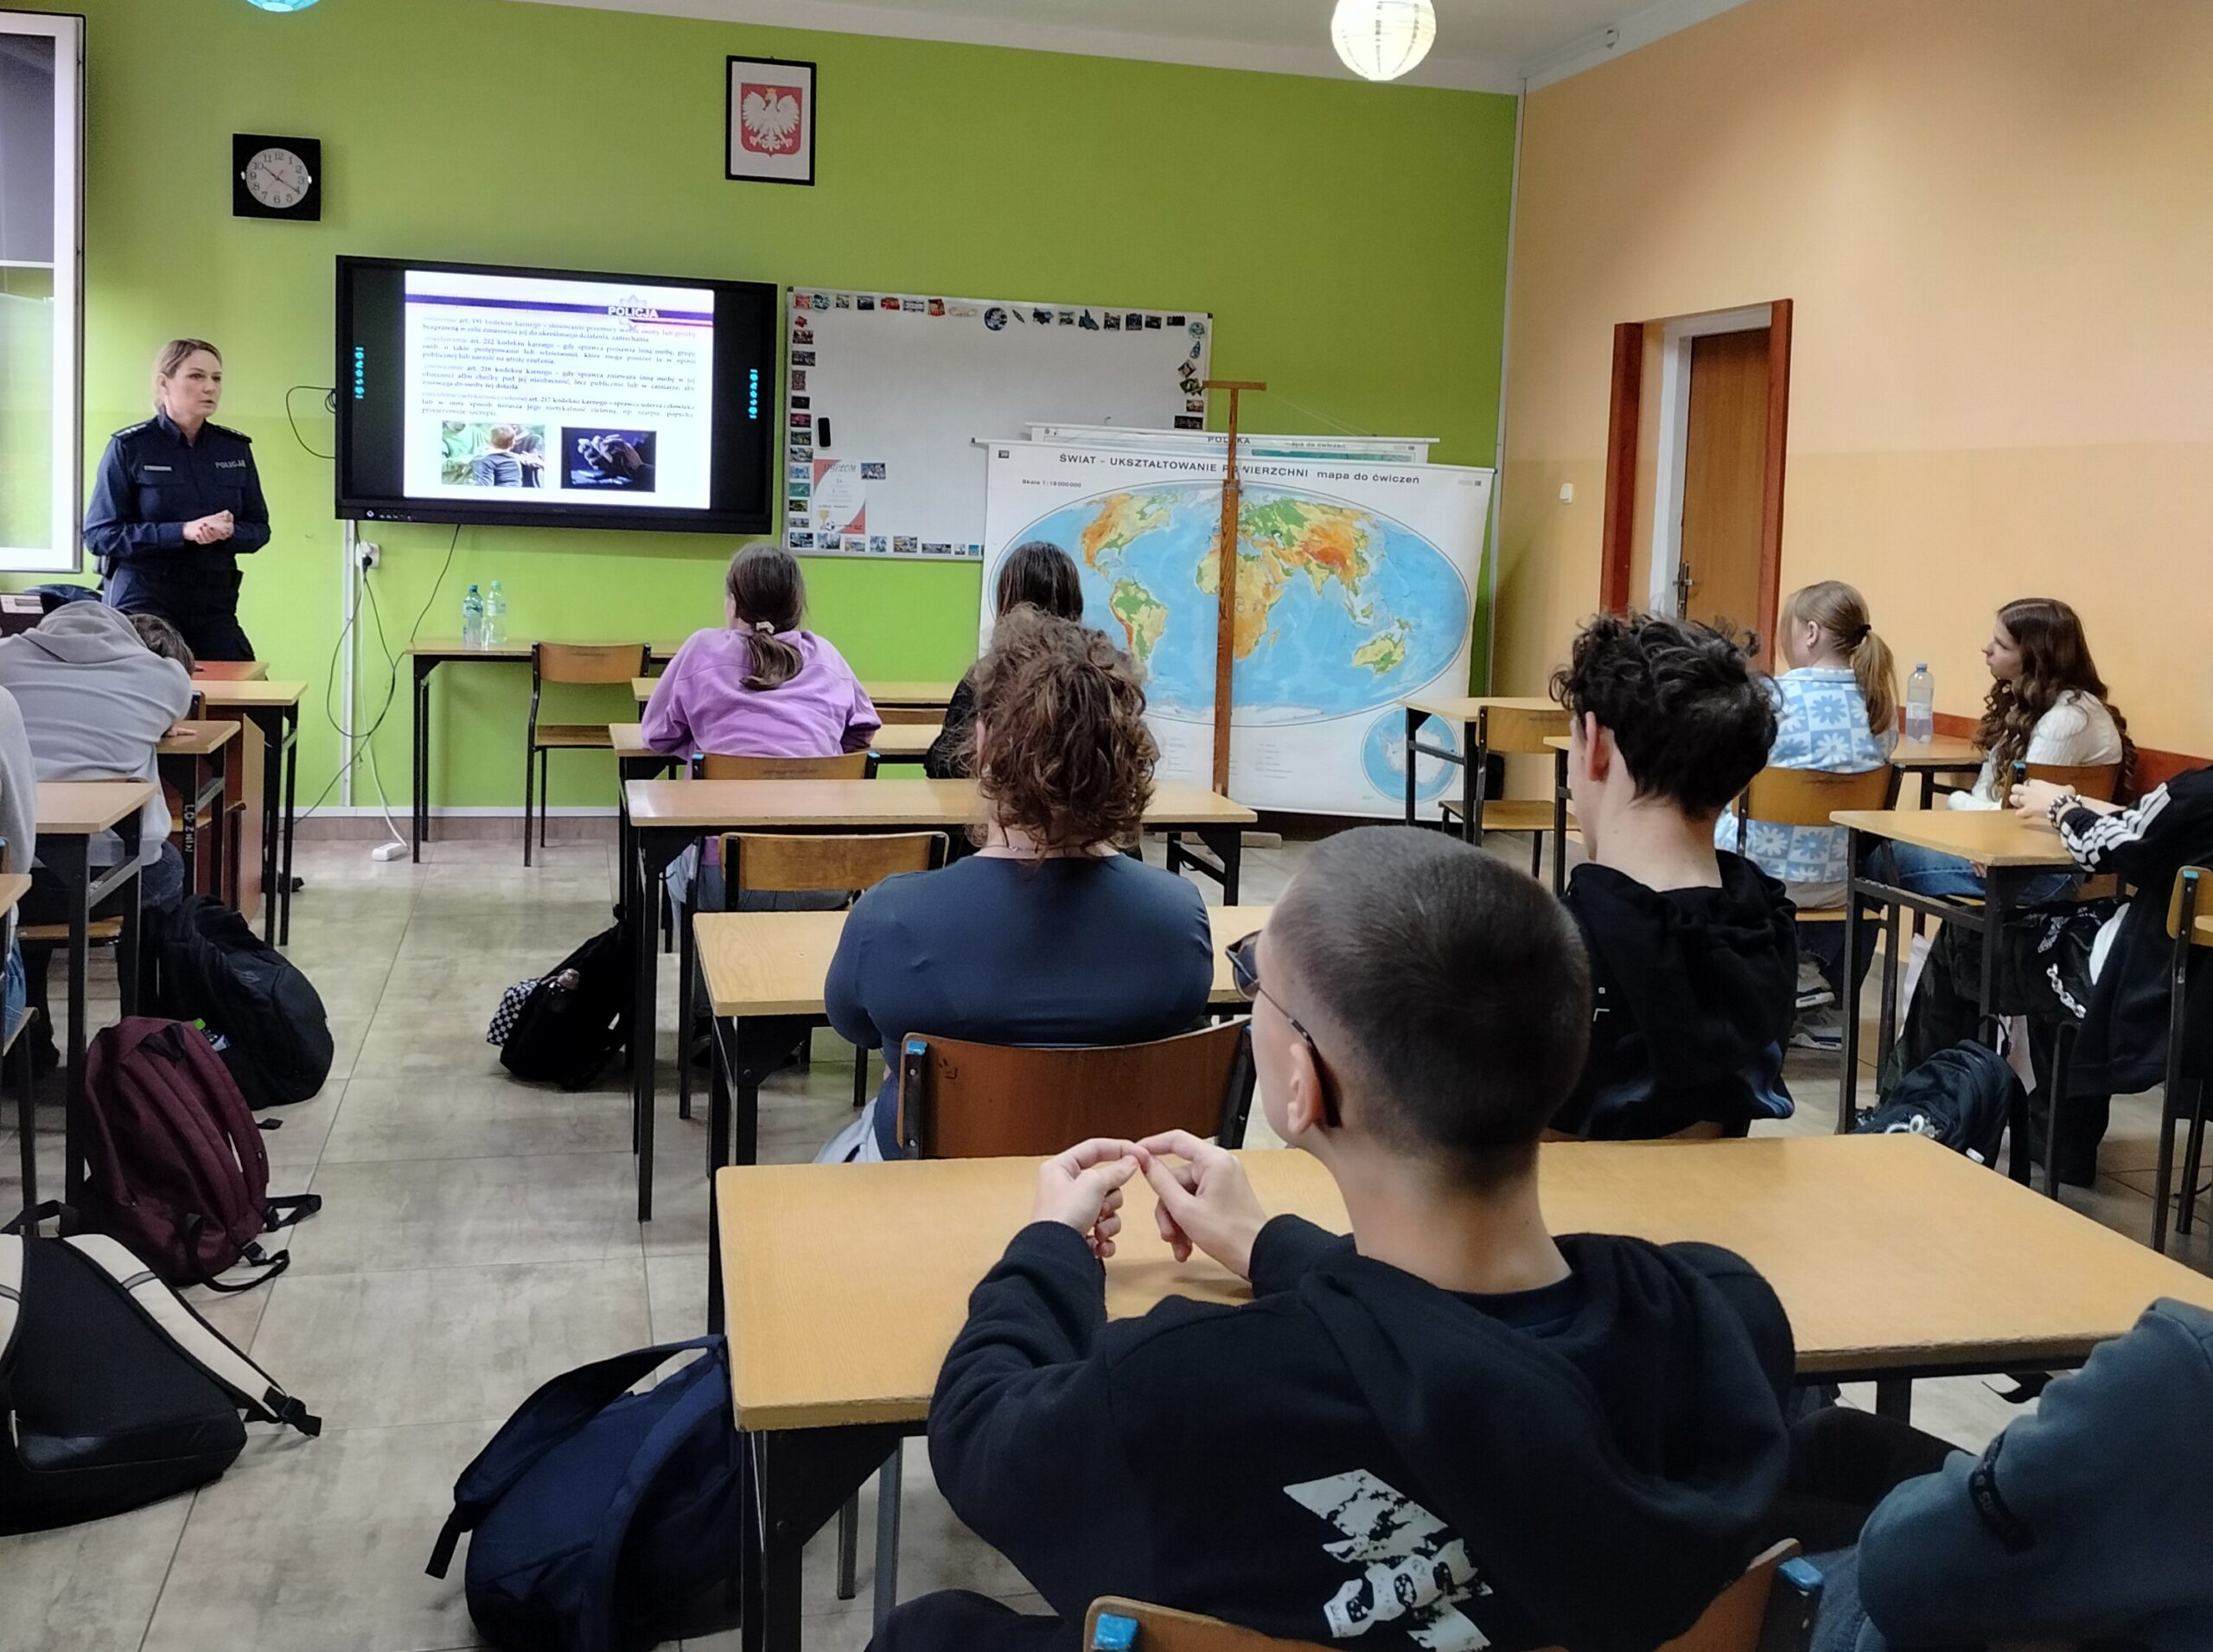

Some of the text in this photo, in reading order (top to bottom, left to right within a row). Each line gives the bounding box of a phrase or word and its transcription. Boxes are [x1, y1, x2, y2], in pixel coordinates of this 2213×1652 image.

[608, 306, 659, 318] POLICJA
[526, 368, 552, 377] karnego
[1059, 453, 1096, 464] ŚWIAT
[1110, 457, 1217, 472] UKSZTAŁTOWANIE
[1317, 470, 1349, 481] mapa
[1354, 471, 1368, 481] do
[1372, 474, 1420, 484] ćwiczeń
